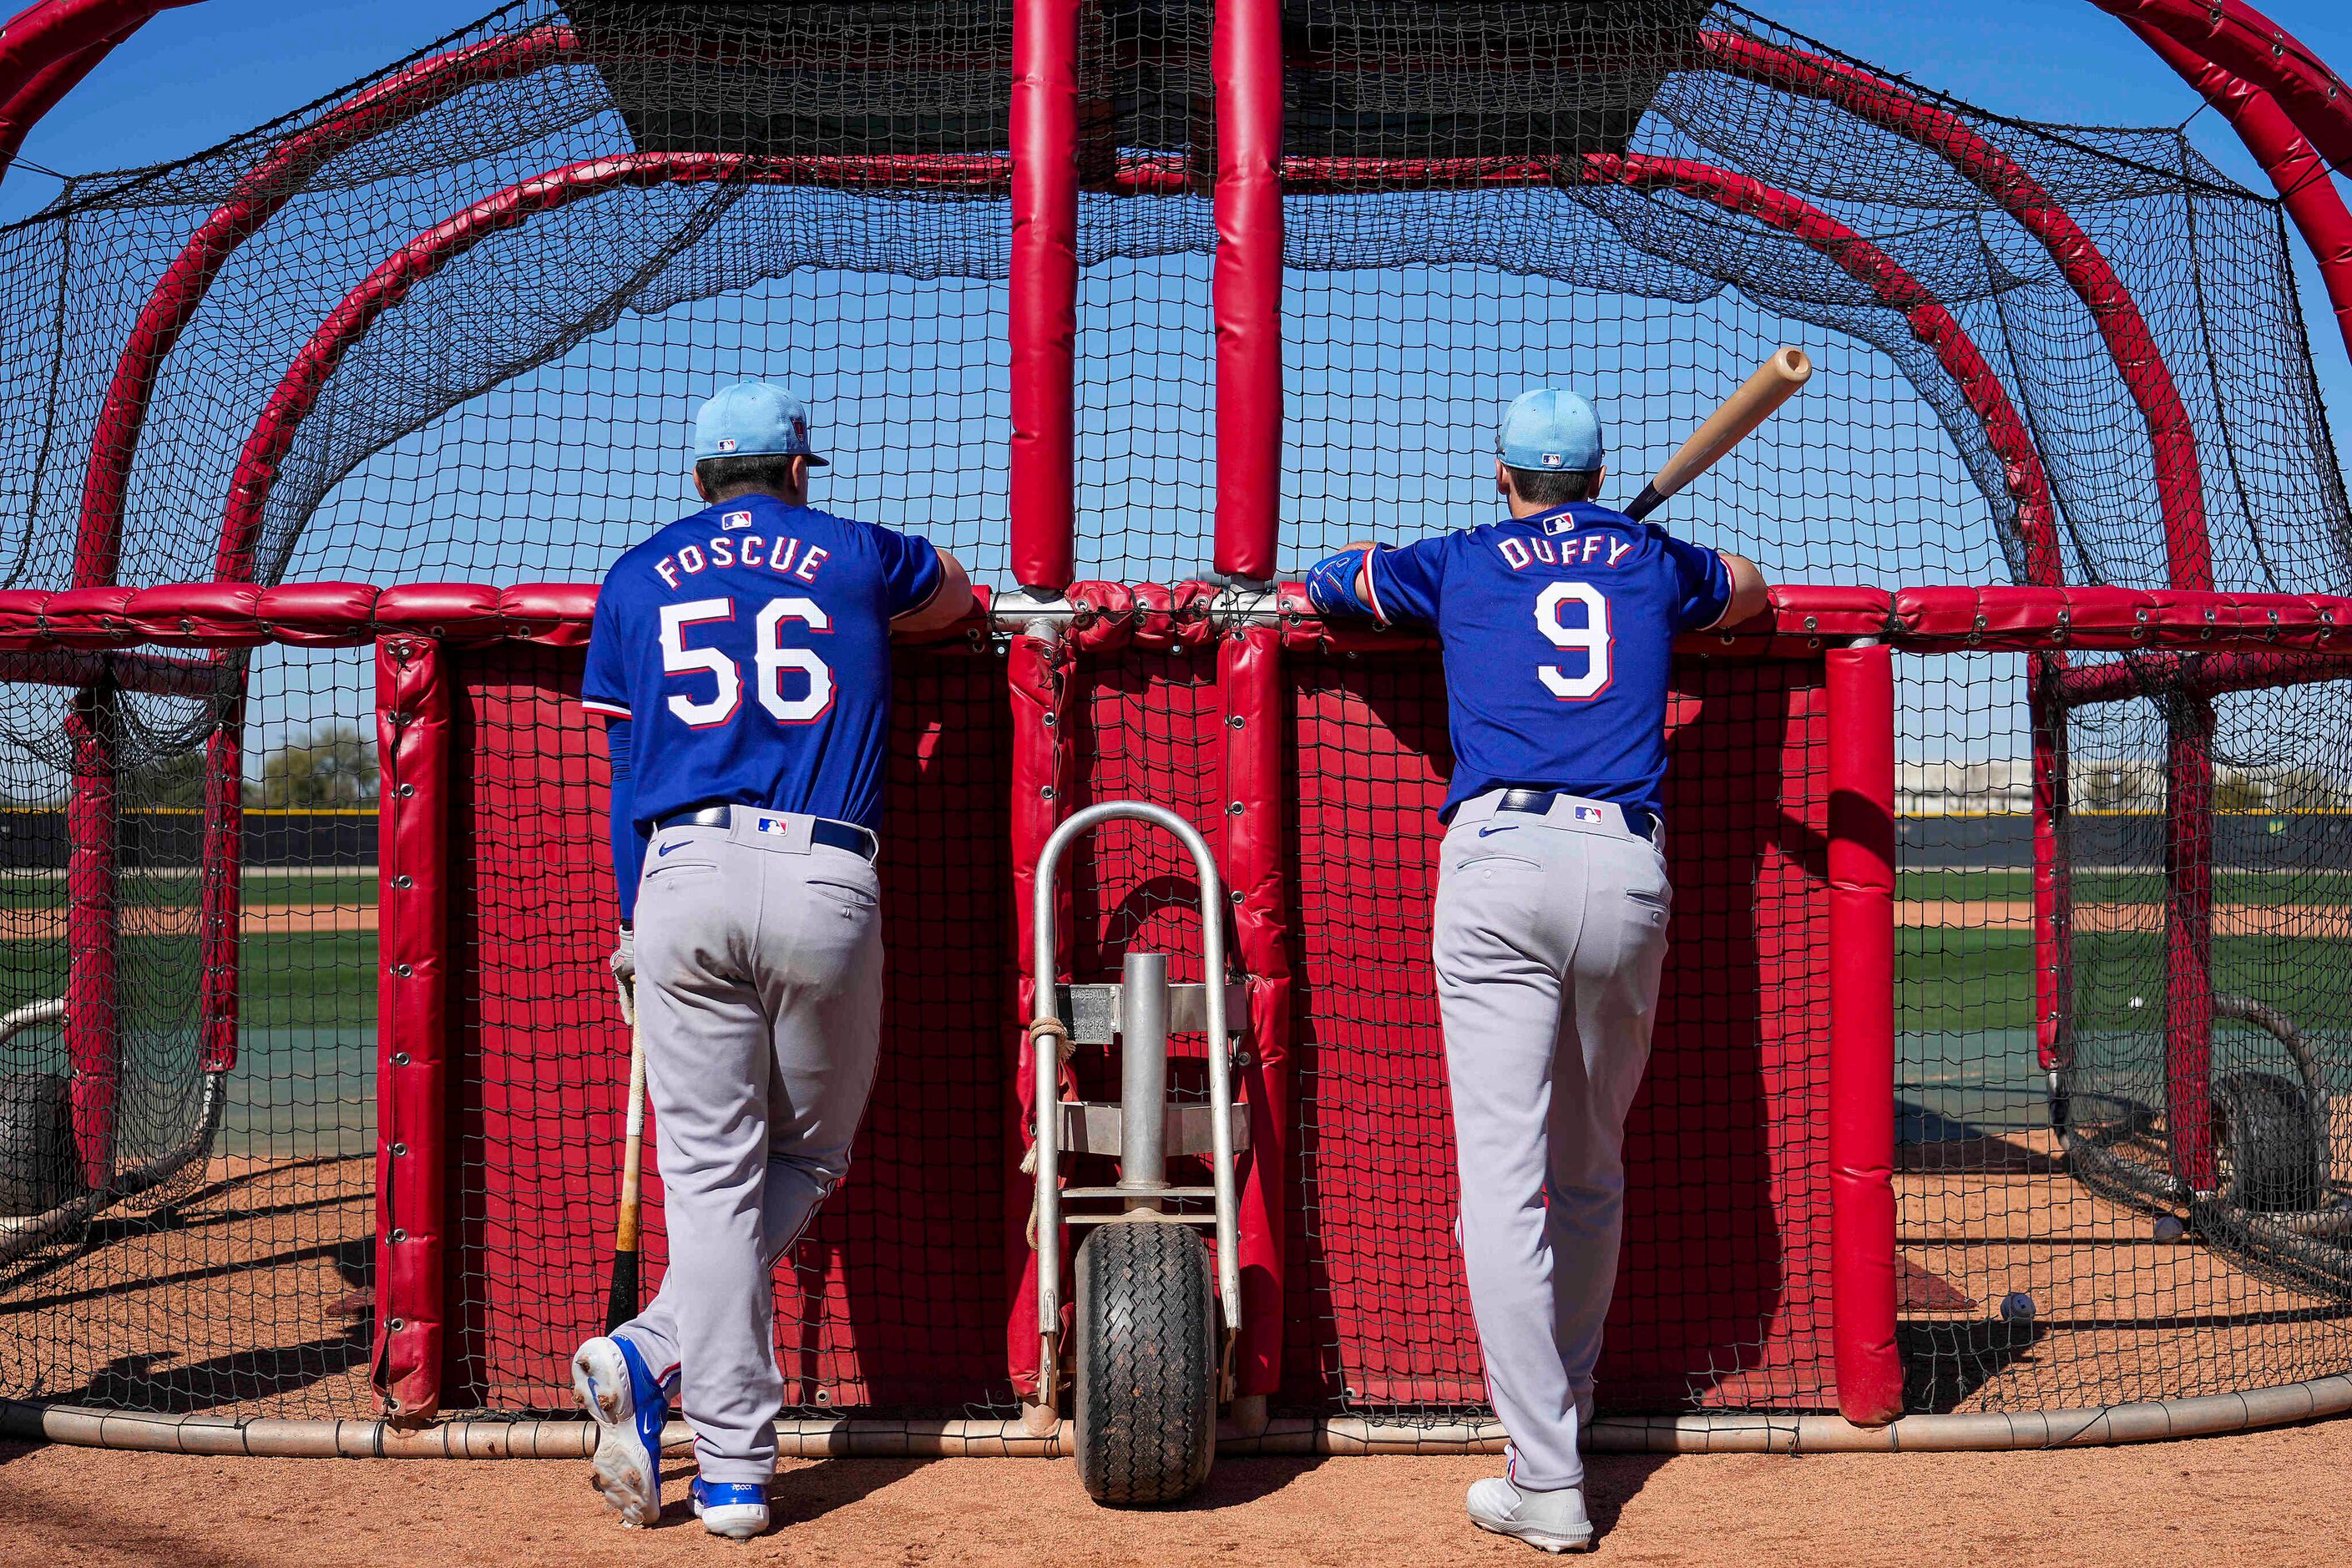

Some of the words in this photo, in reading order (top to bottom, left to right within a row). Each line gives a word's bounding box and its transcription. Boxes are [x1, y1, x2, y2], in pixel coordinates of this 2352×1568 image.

[655, 535, 830, 591] FOSCUE
[1497, 534, 1634, 571] DUFFY
[658, 596, 838, 731] 56
[1534, 580, 1616, 702] 9
[1070, 989, 1107, 1000] BASEBALL
